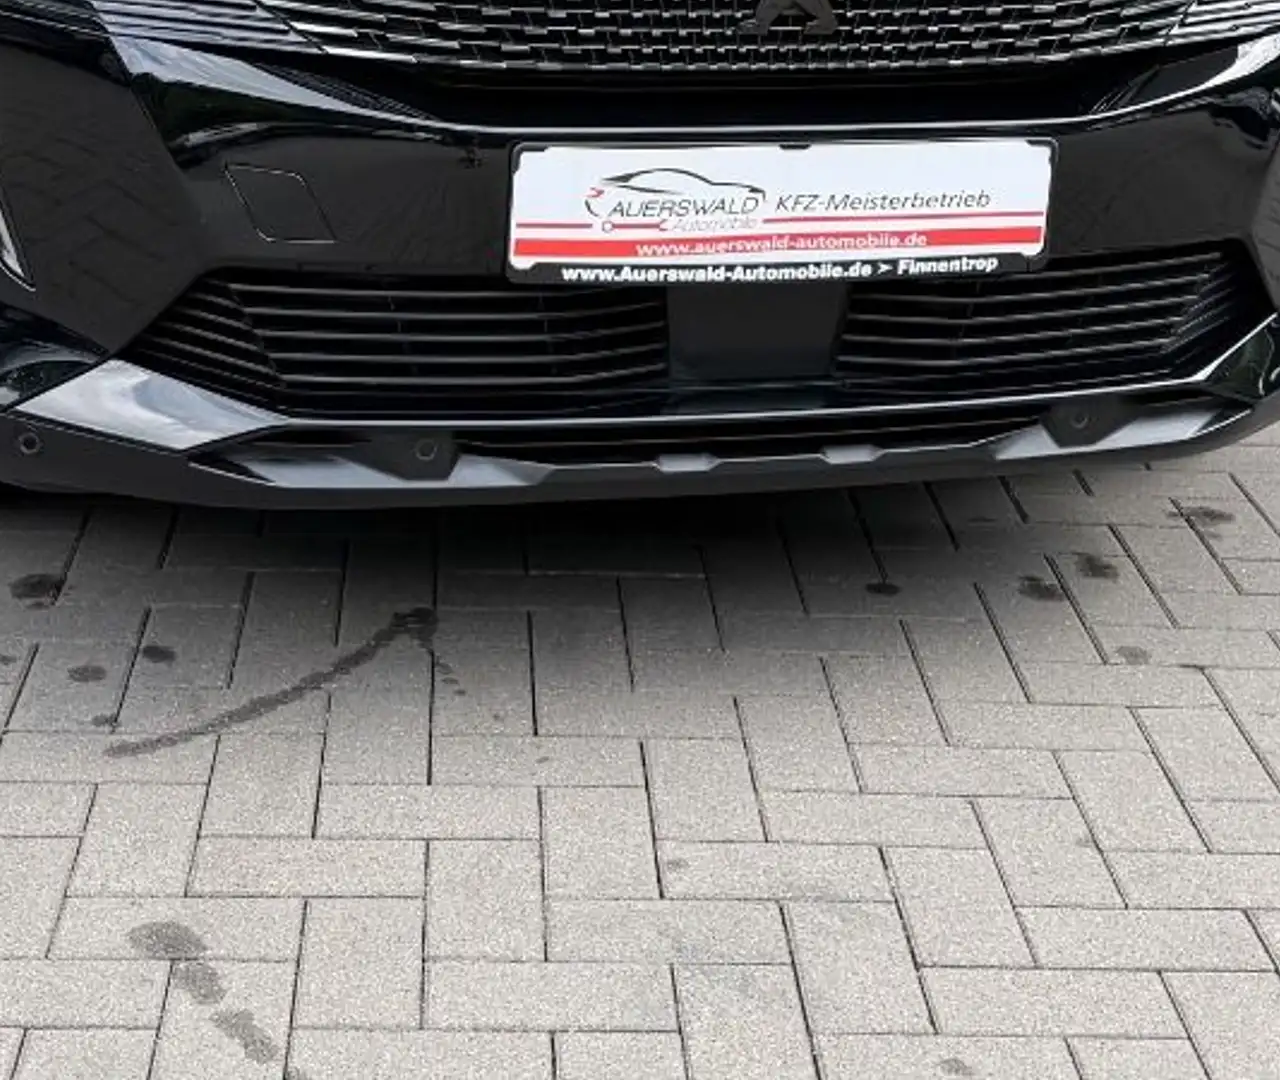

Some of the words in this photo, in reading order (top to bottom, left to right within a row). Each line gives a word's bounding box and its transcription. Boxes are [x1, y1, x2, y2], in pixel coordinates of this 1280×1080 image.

[607, 196, 760, 219] AUERSWALD
[775, 189, 992, 213] KFZ-Meisterbetrieb
[635, 232, 928, 257] www.auerswald-automobile.de
[561, 260, 872, 283] www.Auerswald-Automobile.de
[896, 255, 999, 276] Finnentrop
